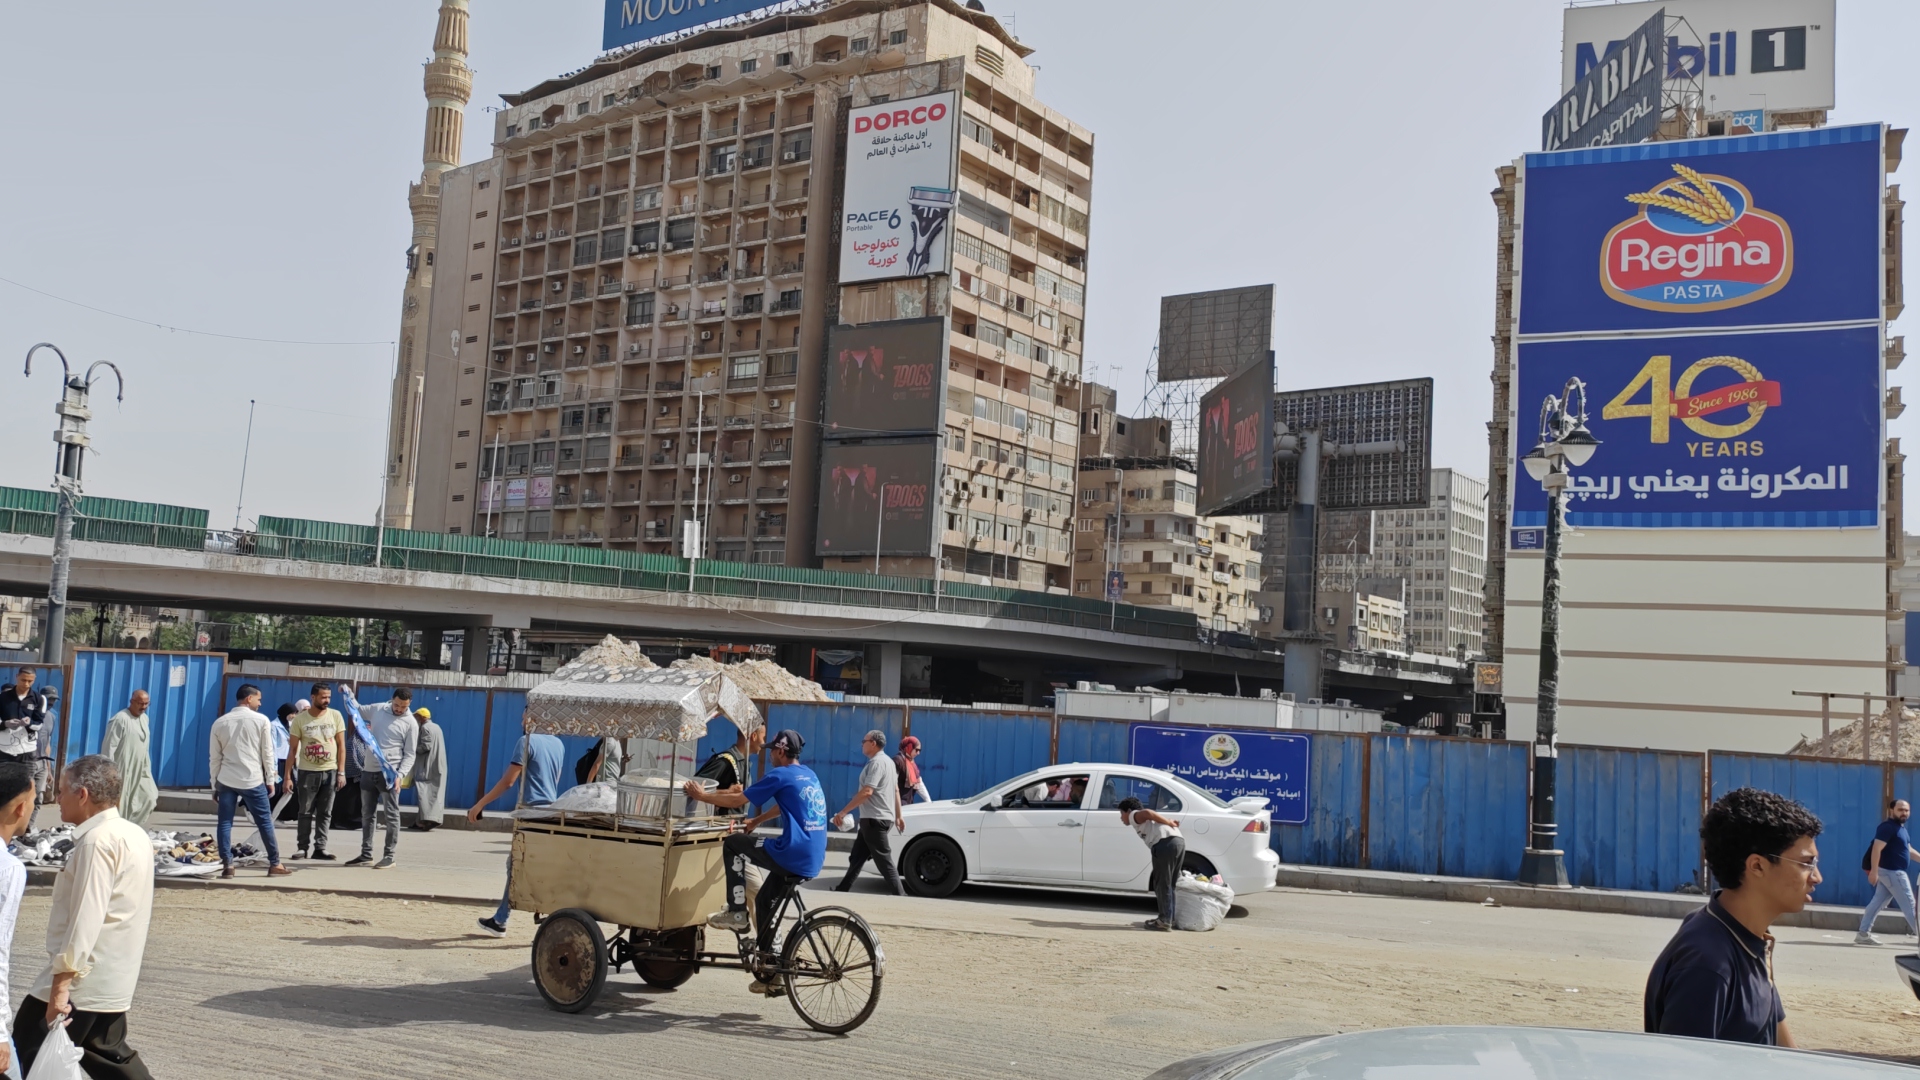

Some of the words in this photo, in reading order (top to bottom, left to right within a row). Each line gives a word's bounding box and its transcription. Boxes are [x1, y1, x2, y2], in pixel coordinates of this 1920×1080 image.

[620, 0, 719, 29] MOU
[1575, 31, 1737, 84] Mbil
[1768, 31, 1785, 68] 1
[1545, 33, 1655, 151] ARABIA
[855, 103, 947, 134] DORCO
[872, 136, 891, 146] حلاقة
[893, 132, 914, 143] ماكينة
[867, 147, 888, 160] العالم
[889, 143, 896, 157] في
[898, 142, 920, 153] شفرات
[846, 224, 873, 232] Portable
[853, 237, 900, 254] تكنولوجيا
[868, 253, 898, 267] كورية
[1620, 236, 1771, 278] Regina
[1663, 284, 1724, 300] PASTA
[1602, 355, 1768, 443] 40
[1687, 397, 1723, 415] Since
[1727, 387, 1758, 403] 1986
[1686, 440, 1764, 458] YEARS
[1628, 468, 1709, 498] يعني
[1717, 465, 1848, 498] المكرونة
[1196, 767, 1249, 781] الميكروباص
[1250, 769, 1281, 782] موقف
